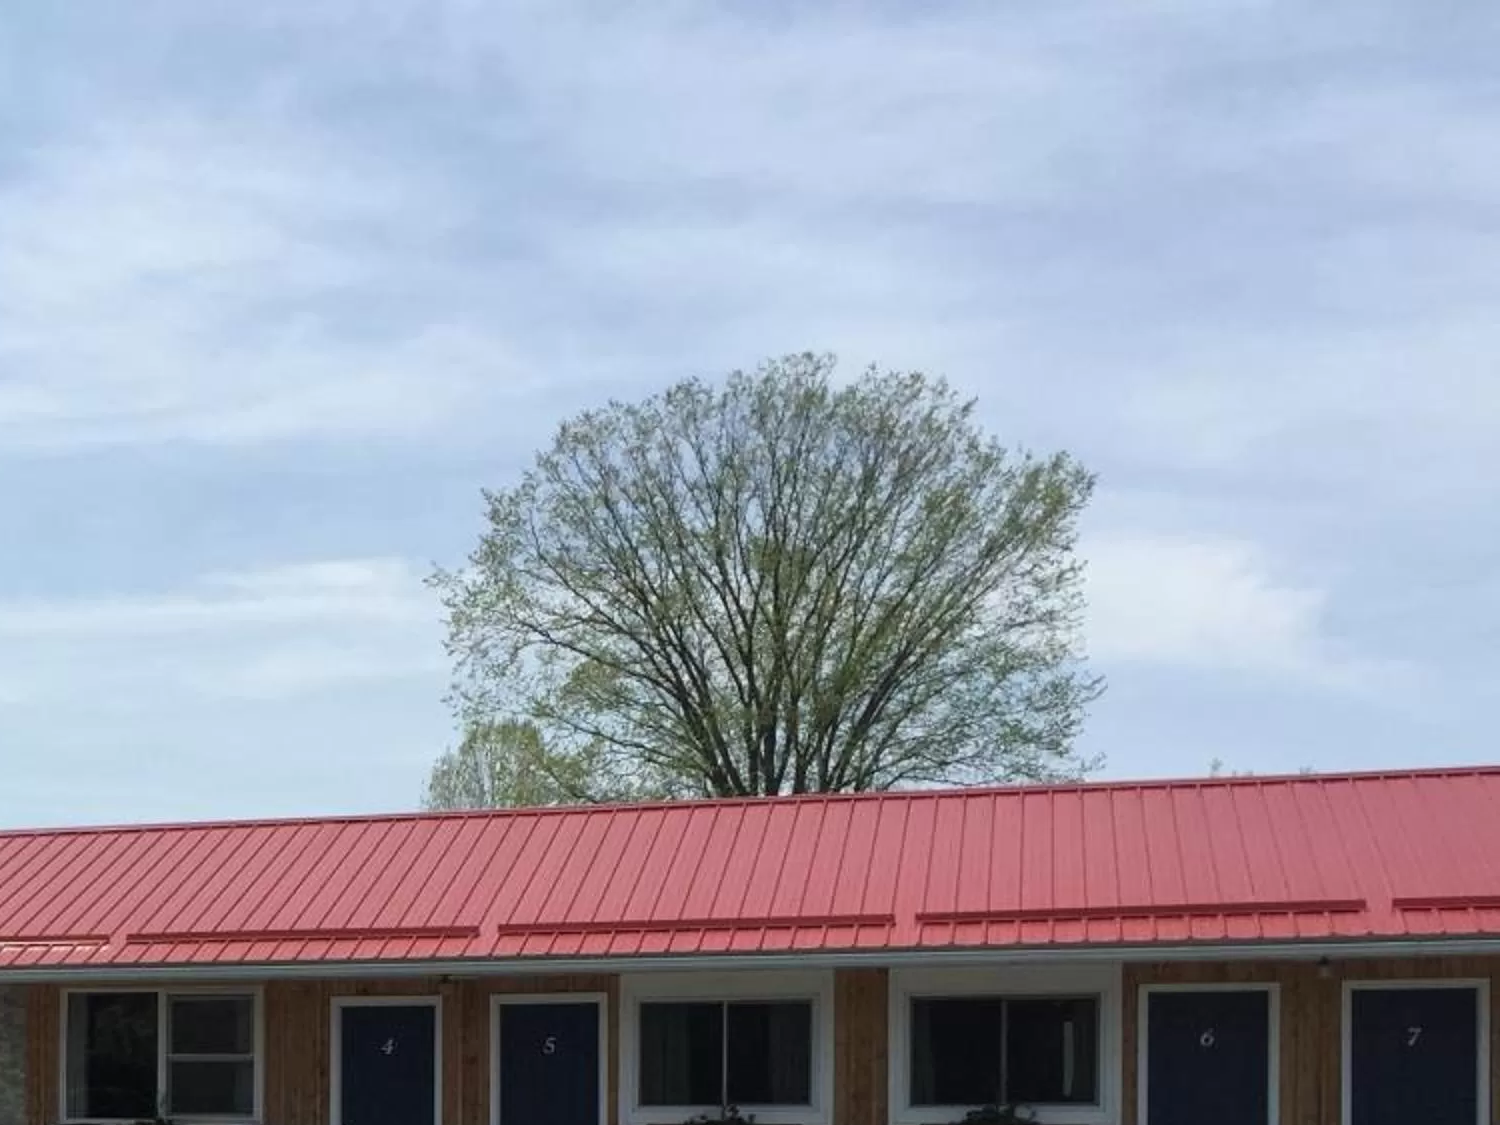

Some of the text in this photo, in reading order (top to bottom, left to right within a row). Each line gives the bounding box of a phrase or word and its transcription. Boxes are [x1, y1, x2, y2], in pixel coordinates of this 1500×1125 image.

[380, 1037, 395, 1055] 4
[543, 1037, 556, 1055] 5
[1200, 1028, 1215, 1047] 6
[1407, 1027, 1422, 1047] 7
